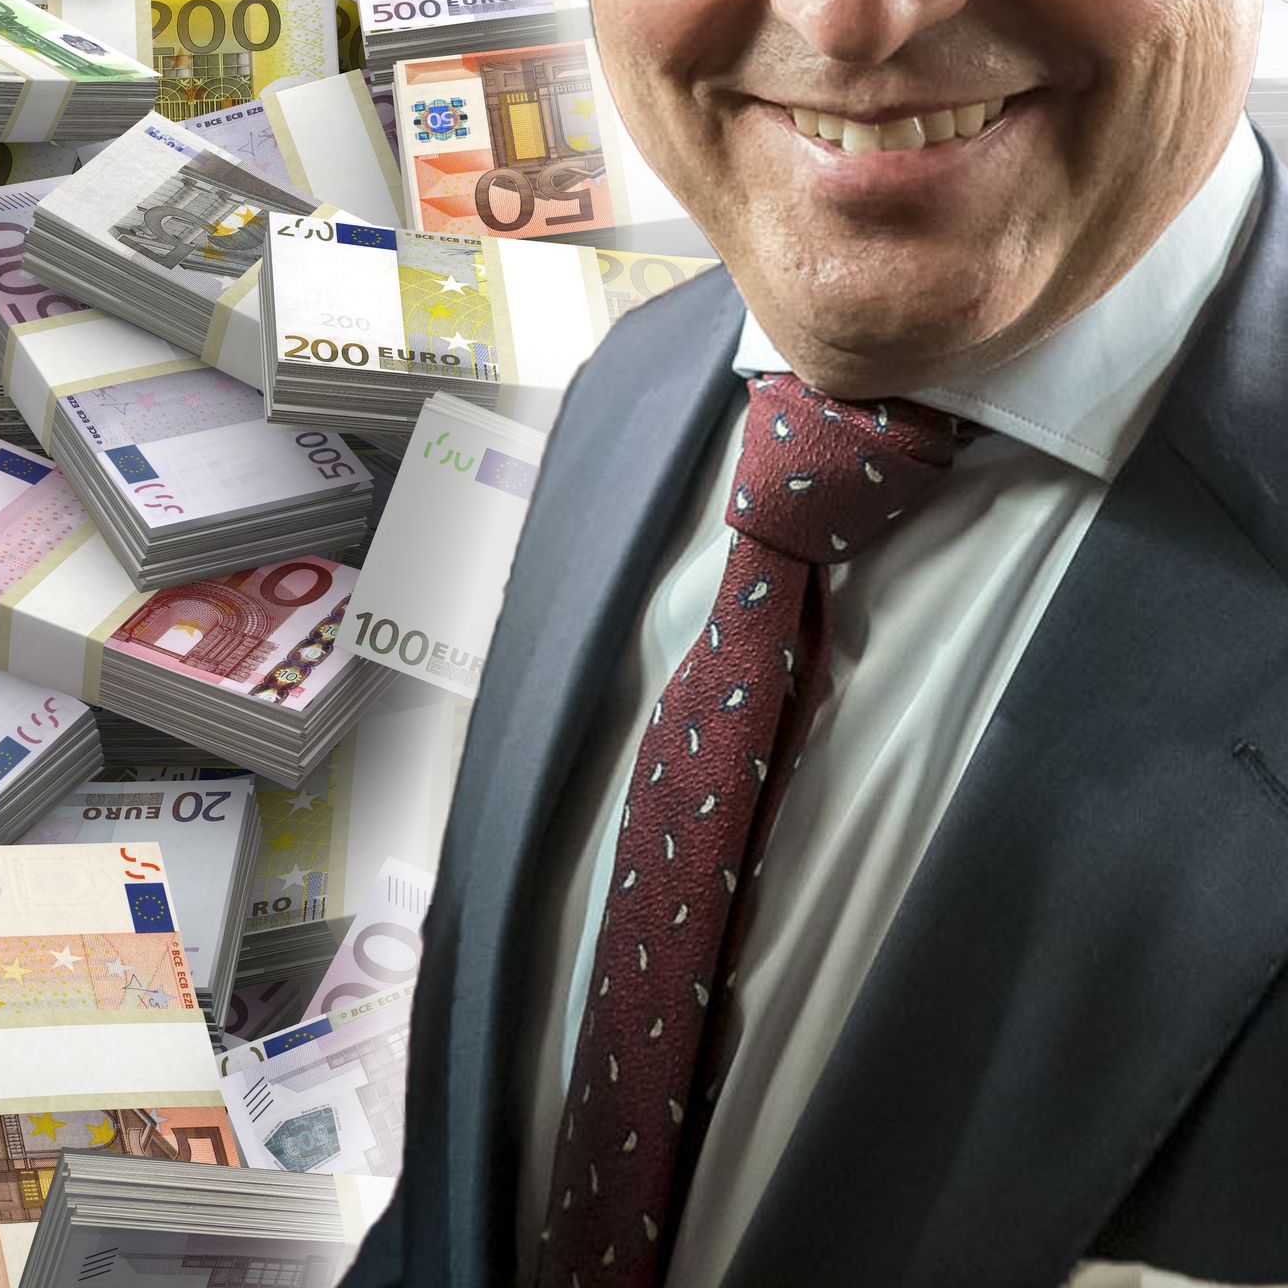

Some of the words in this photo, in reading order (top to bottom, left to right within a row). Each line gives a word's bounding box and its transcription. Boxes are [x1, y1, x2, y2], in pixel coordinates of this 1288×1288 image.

[373, 1, 441, 23] 500
[204, 117, 222, 128] BCE
[225, 113, 243, 123] ECB
[246, 107, 264, 116] EZB
[427, 111, 456, 129] 50
[475, 161, 594, 232] 50
[415, 233, 434, 241] BCE
[440, 235, 459, 243] ECB
[284, 335, 369, 366] 200
[378, 347, 460, 365] EURO
[355, 612, 428, 666] 100
[82, 806, 159, 819] EURO
[172, 792, 232, 820] 20
[172, 950, 184, 969] BCE
[178, 971, 190, 989] ECB
[184, 992, 196, 1009] EZB
